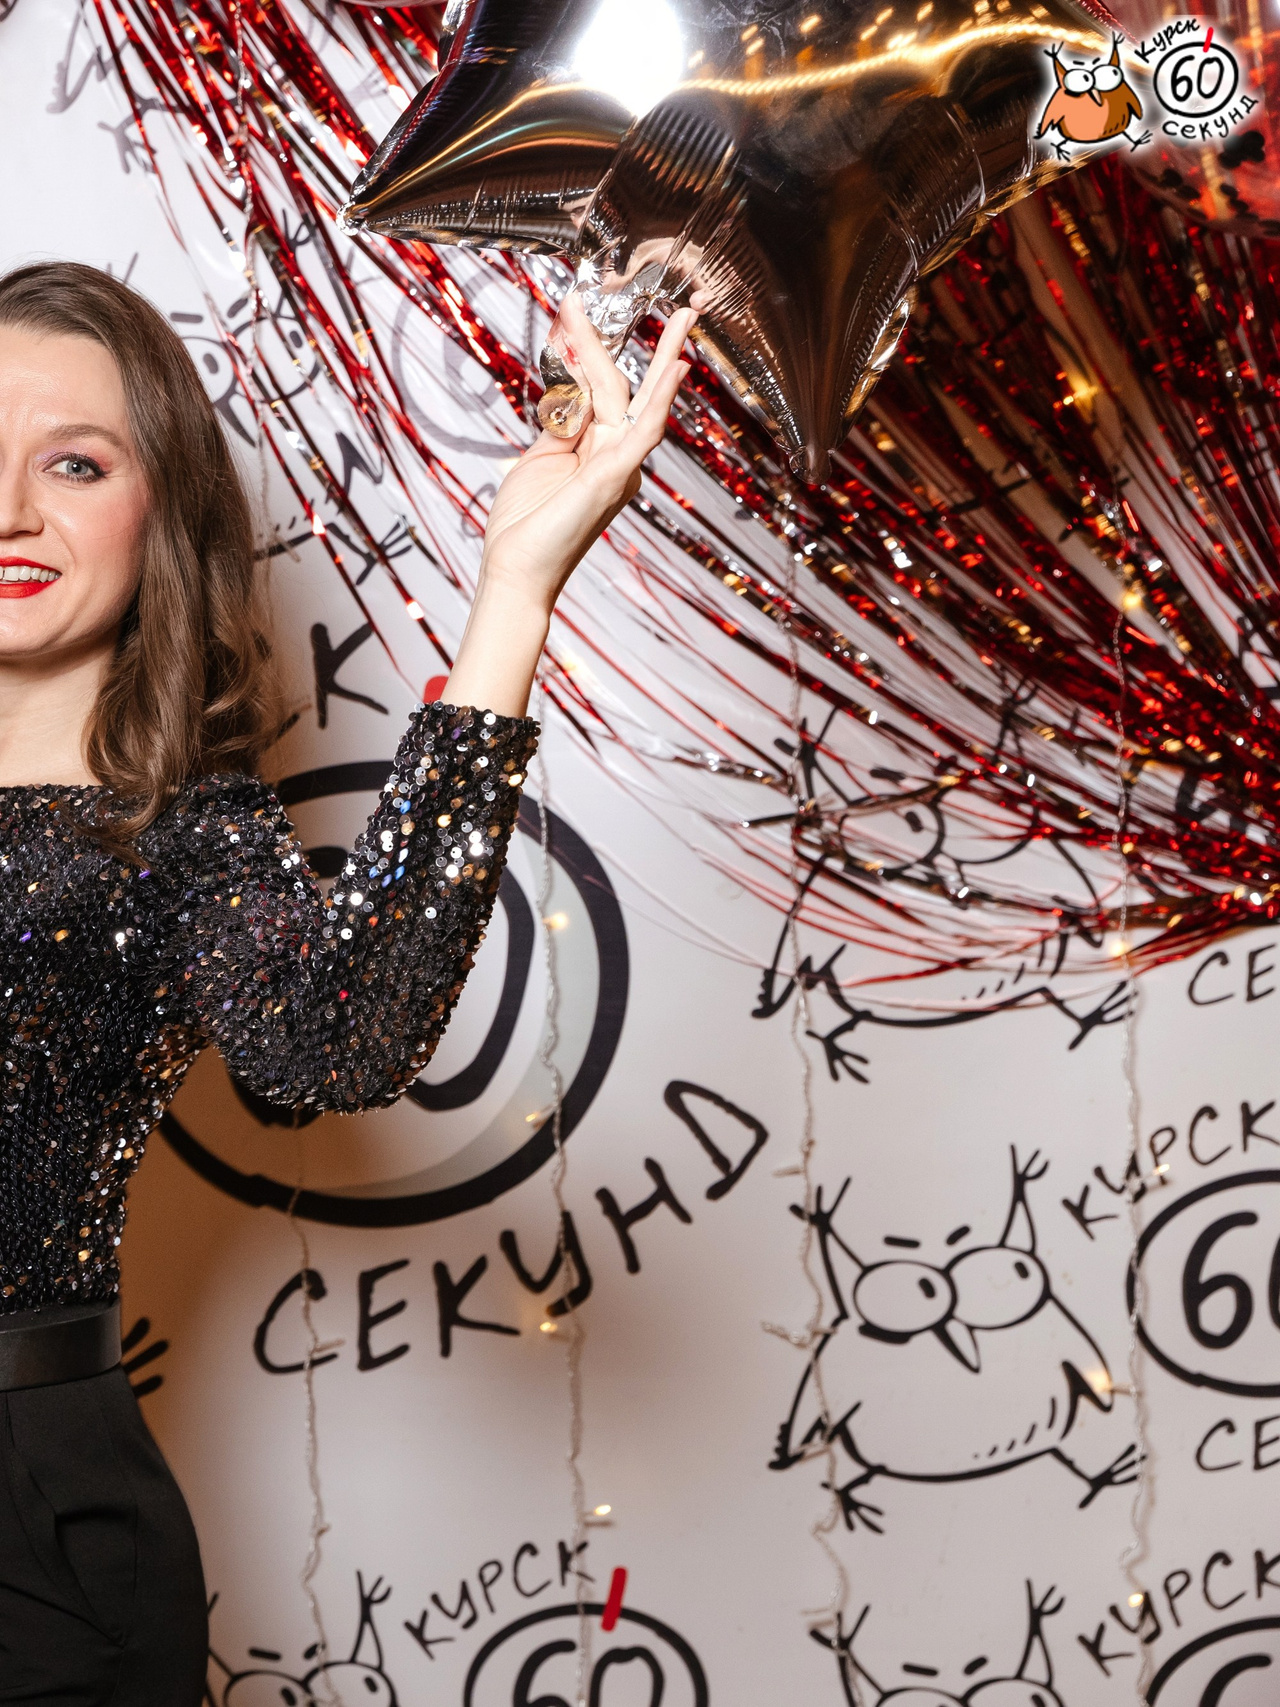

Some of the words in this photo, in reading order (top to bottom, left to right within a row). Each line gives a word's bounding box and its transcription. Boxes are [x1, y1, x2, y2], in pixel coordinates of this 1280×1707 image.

[1061, 1100, 1280, 1240] КУРСК
[1181, 1210, 1280, 1350] 6
[403, 1540, 596, 1661] КУРСК
